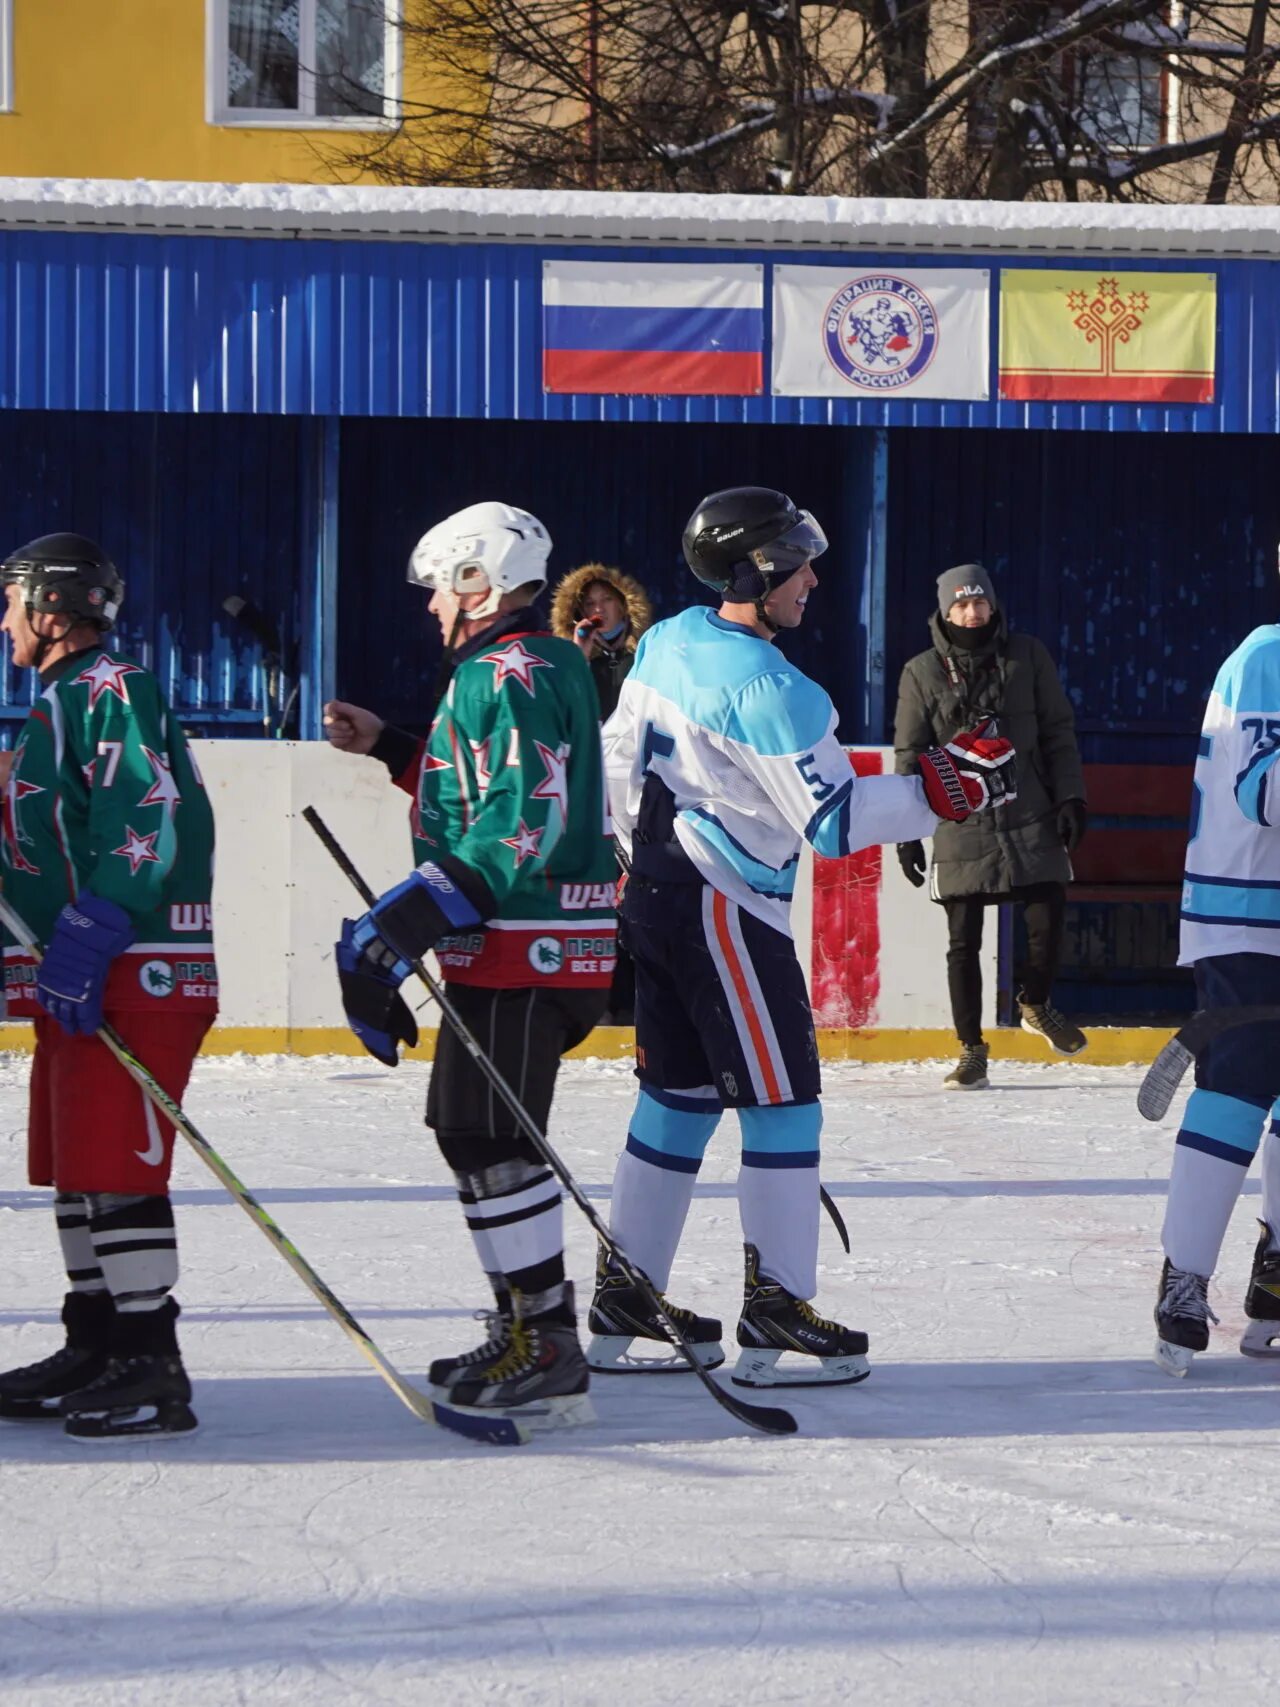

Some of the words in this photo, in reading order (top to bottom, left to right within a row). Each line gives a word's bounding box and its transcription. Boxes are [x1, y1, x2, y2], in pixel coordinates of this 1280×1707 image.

[827, 279, 894, 333] ФЕДЕРАЦИЯ
[897, 285, 935, 334] ХОККЕЯ
[850, 369, 911, 387] РОССИИ
[716, 527, 745, 543] BAUER
[954, 584, 985, 599] FILA
[97, 741, 122, 787] 7
[795, 752, 836, 801] 5
[571, 959, 598, 973] ВСЕ
[797, 1329, 829, 1345] CCM
